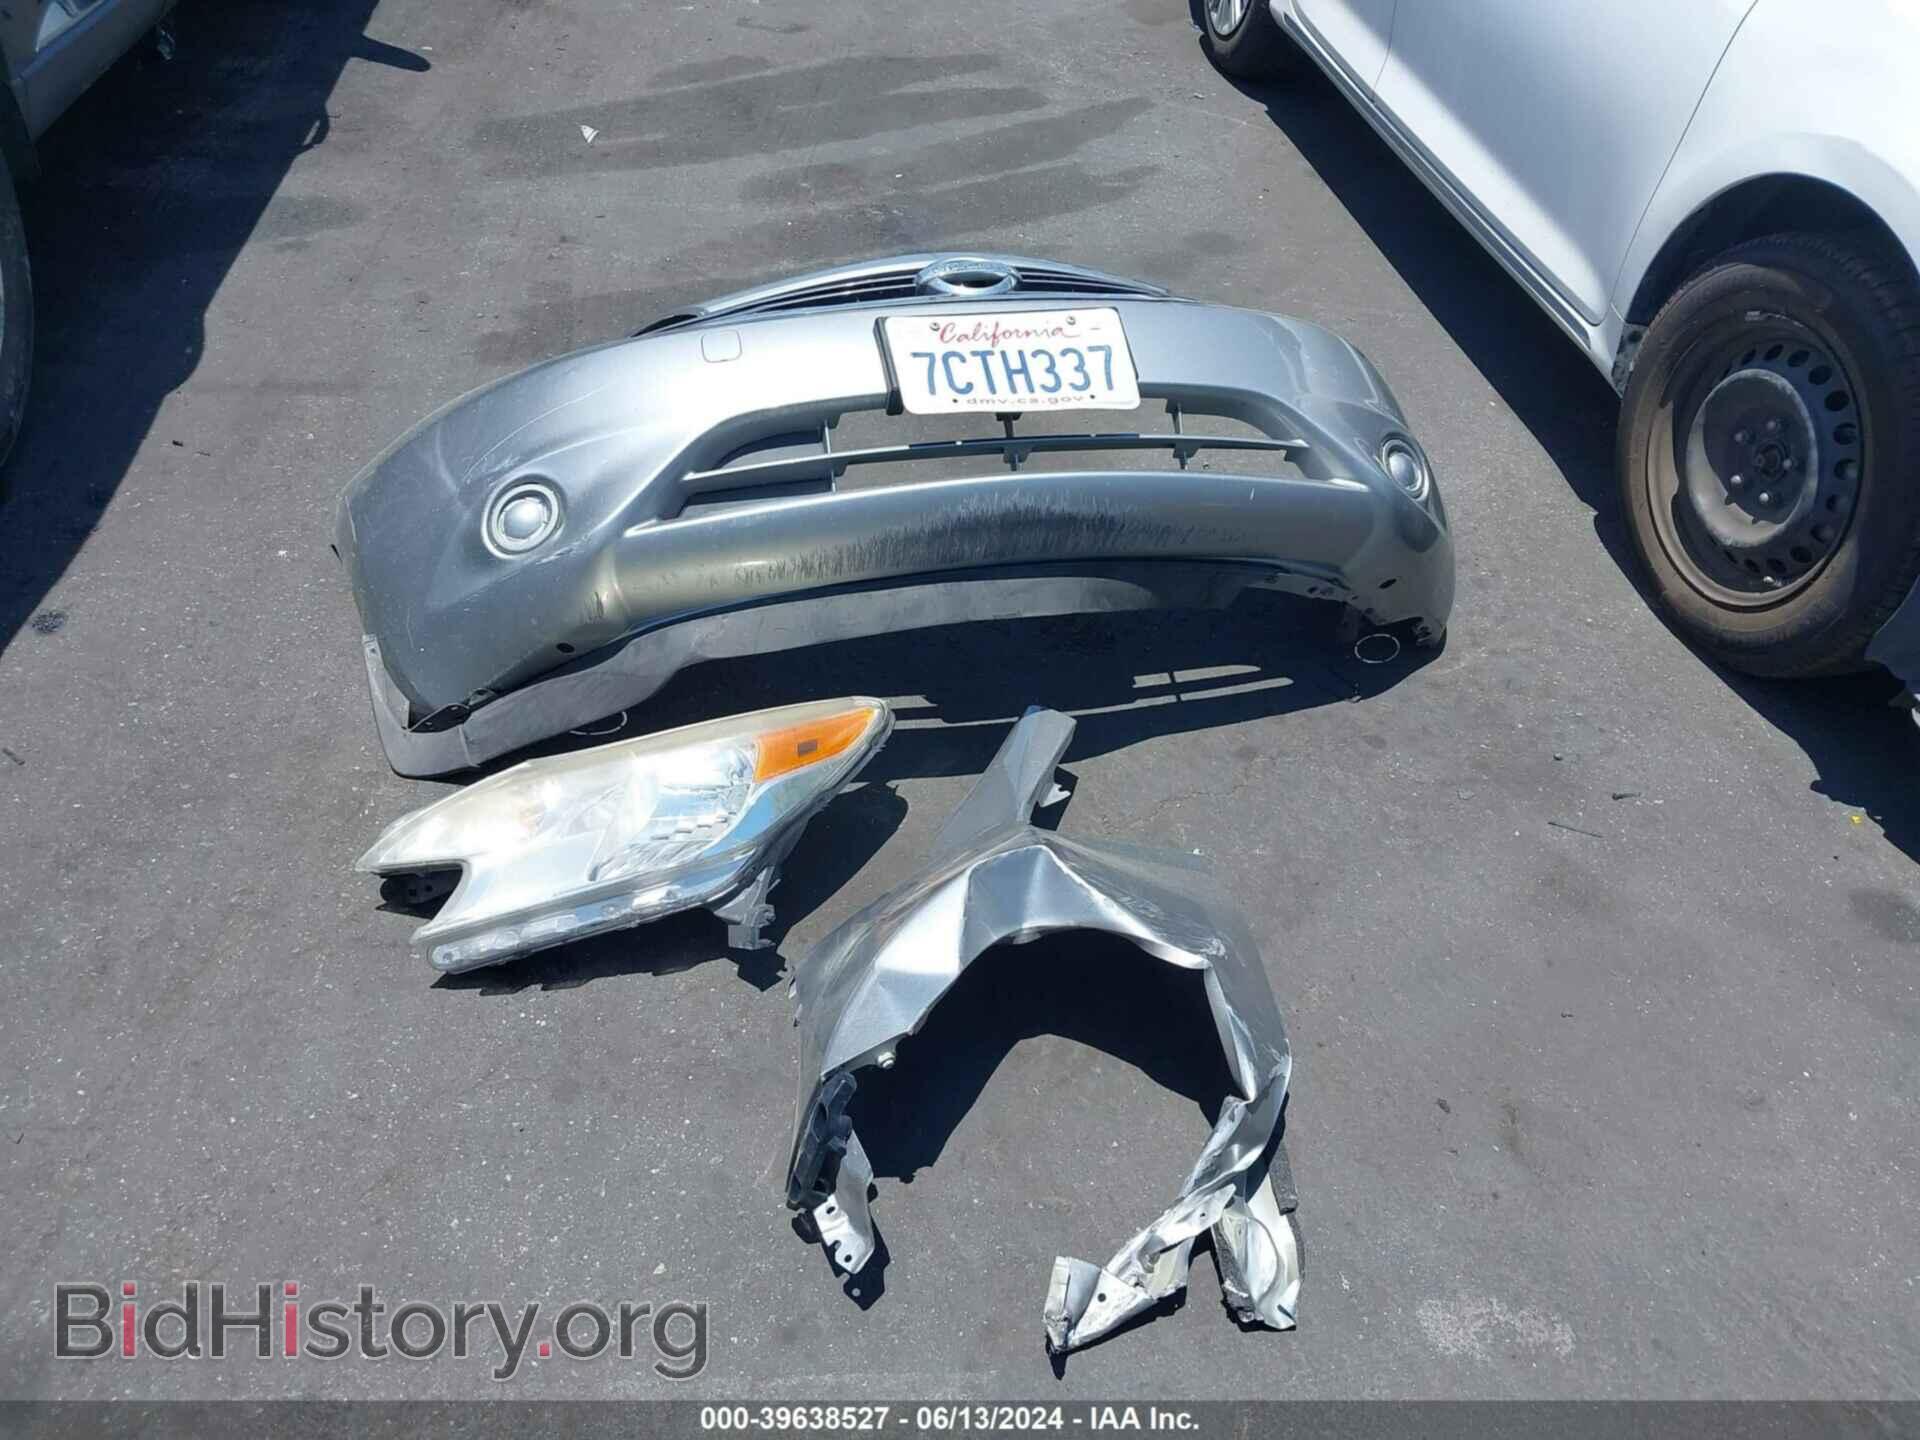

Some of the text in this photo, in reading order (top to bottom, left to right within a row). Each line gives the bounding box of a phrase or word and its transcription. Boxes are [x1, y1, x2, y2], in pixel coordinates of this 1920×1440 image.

[938, 321, 1080, 348] California
[911, 344, 1114, 395] 7CTH337
[966, 395, 1085, 405] dmv.ca.gov
